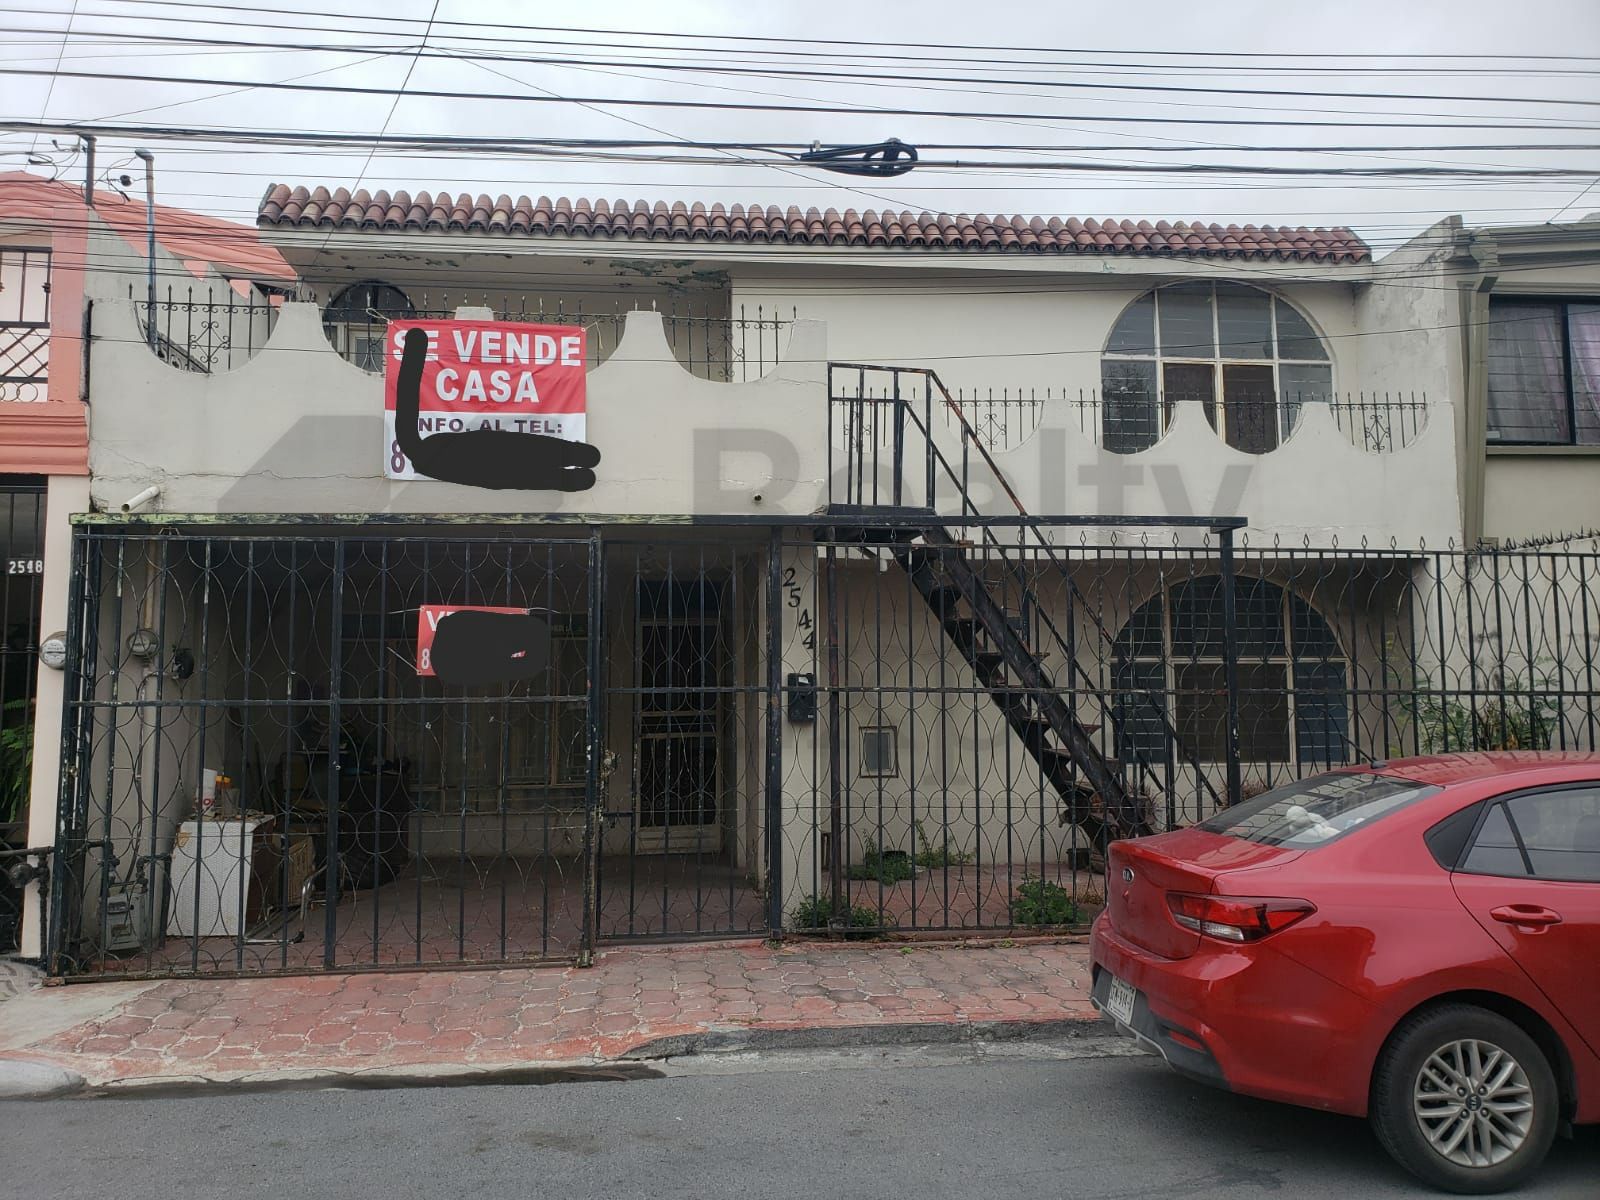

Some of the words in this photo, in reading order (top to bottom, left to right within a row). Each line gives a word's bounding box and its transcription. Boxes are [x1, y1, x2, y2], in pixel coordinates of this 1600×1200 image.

[452, 330, 582, 367] VENDE
[435, 368, 539, 403] CASA
[417, 417, 471, 432] NFO.
[514, 419, 563, 434] TEL:
[8, 560, 43, 574] 2548
